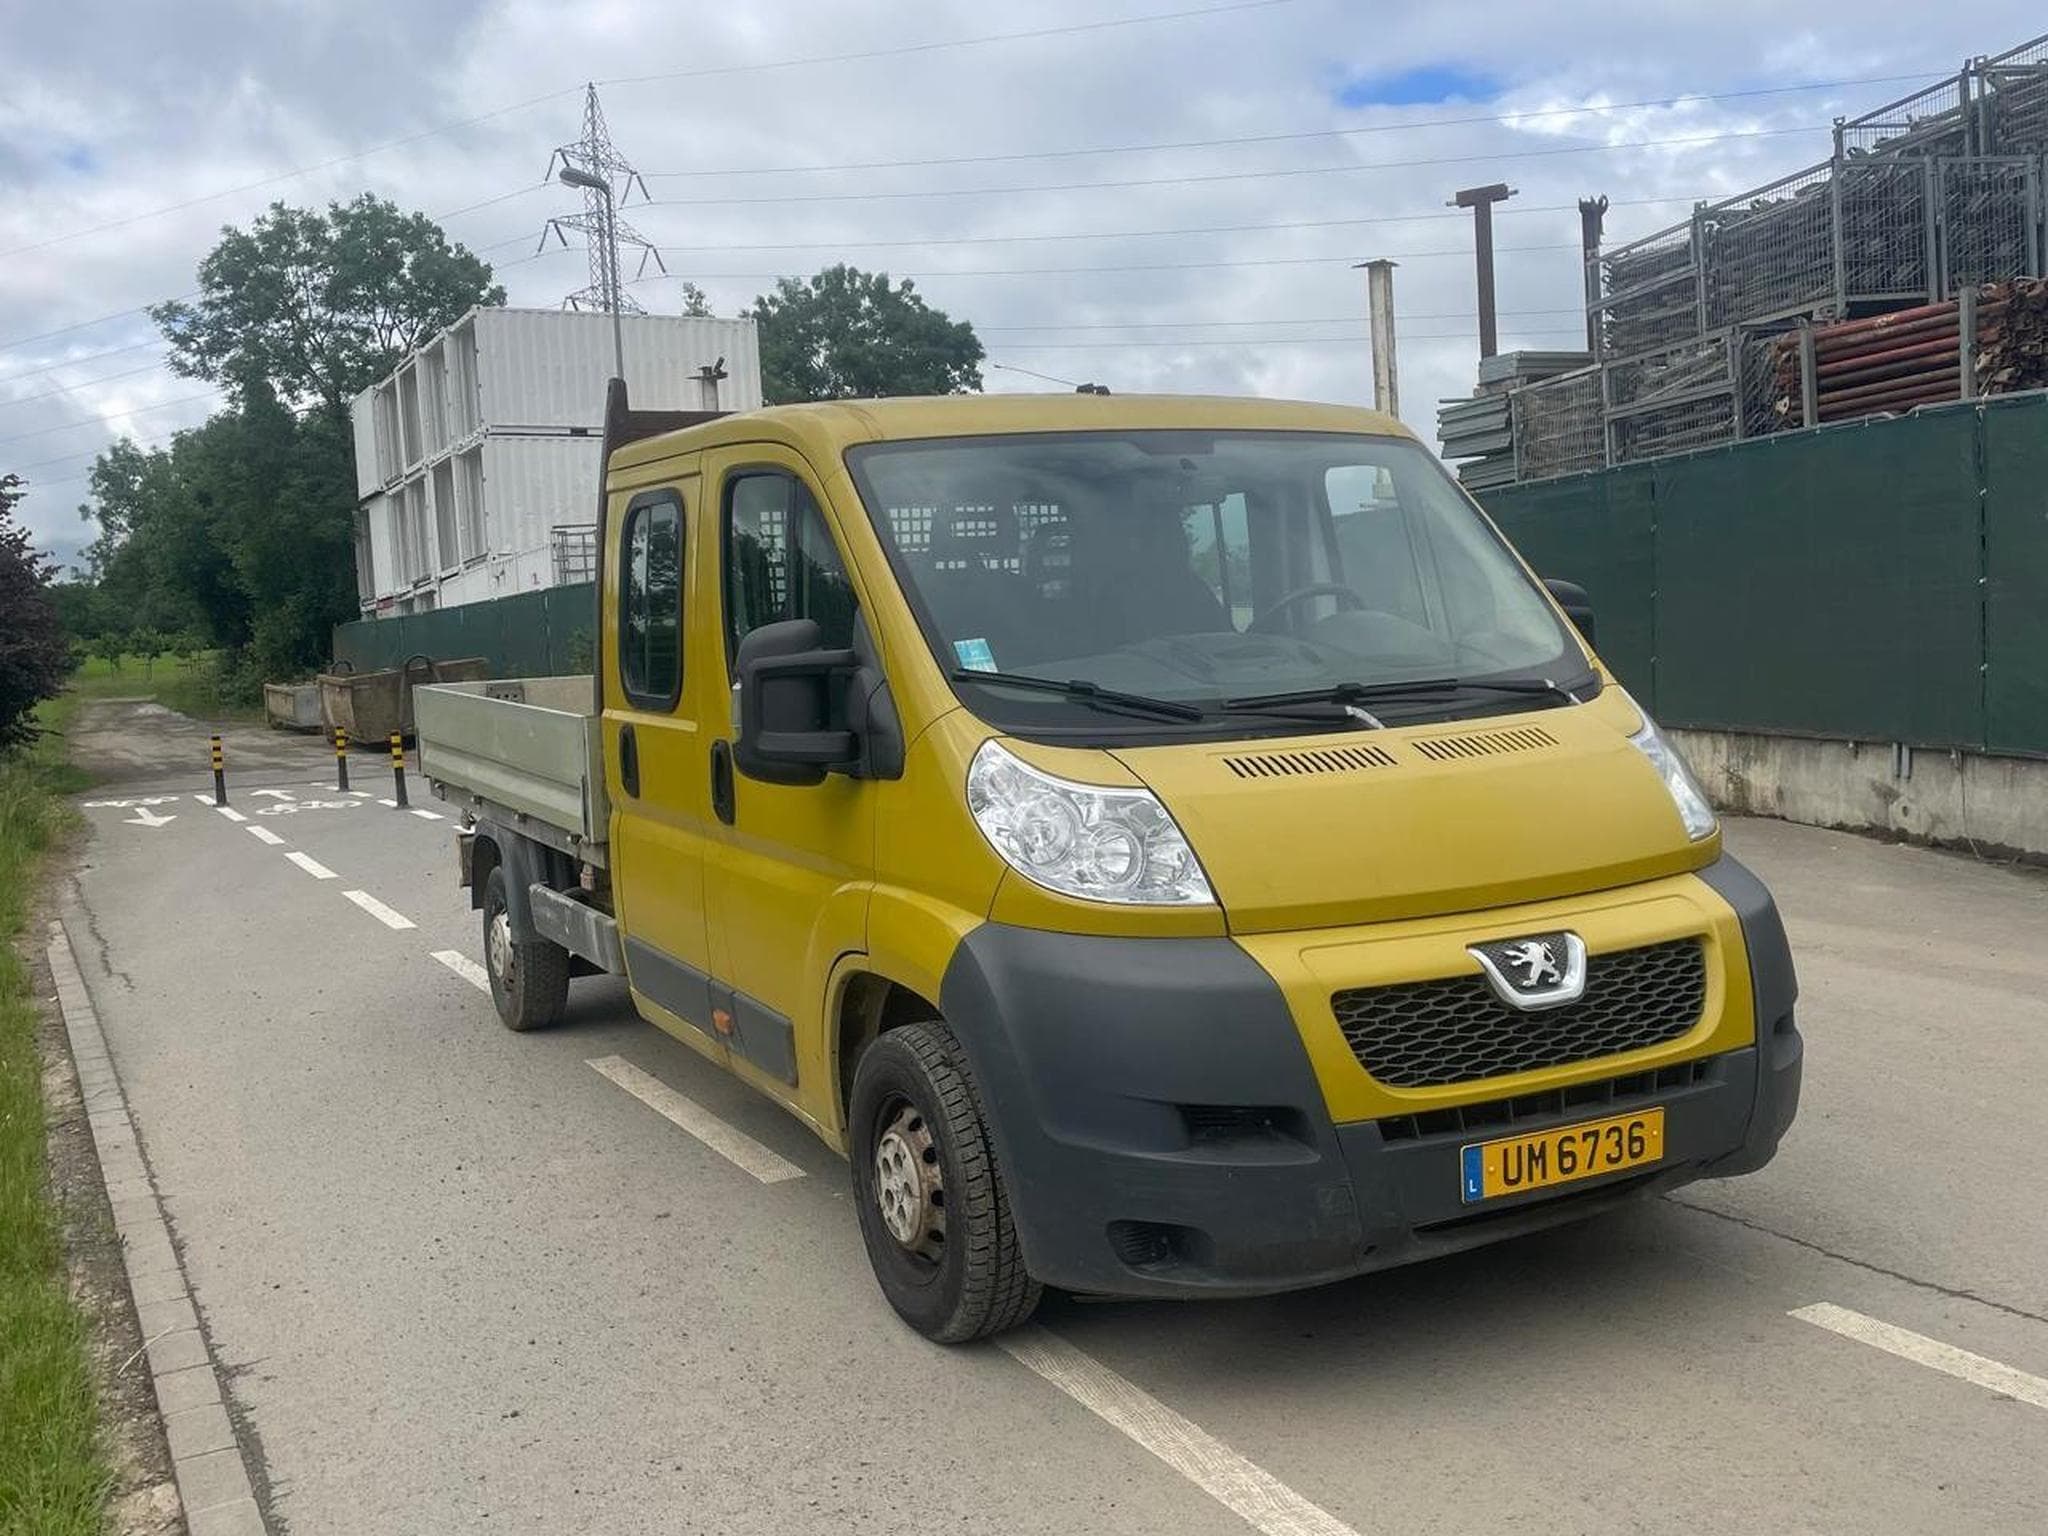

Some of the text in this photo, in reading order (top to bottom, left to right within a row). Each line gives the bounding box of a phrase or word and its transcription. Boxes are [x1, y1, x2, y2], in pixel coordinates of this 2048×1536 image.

[1503, 1121, 1645, 1187] UM 6736
[1469, 1179, 1478, 1193] L
